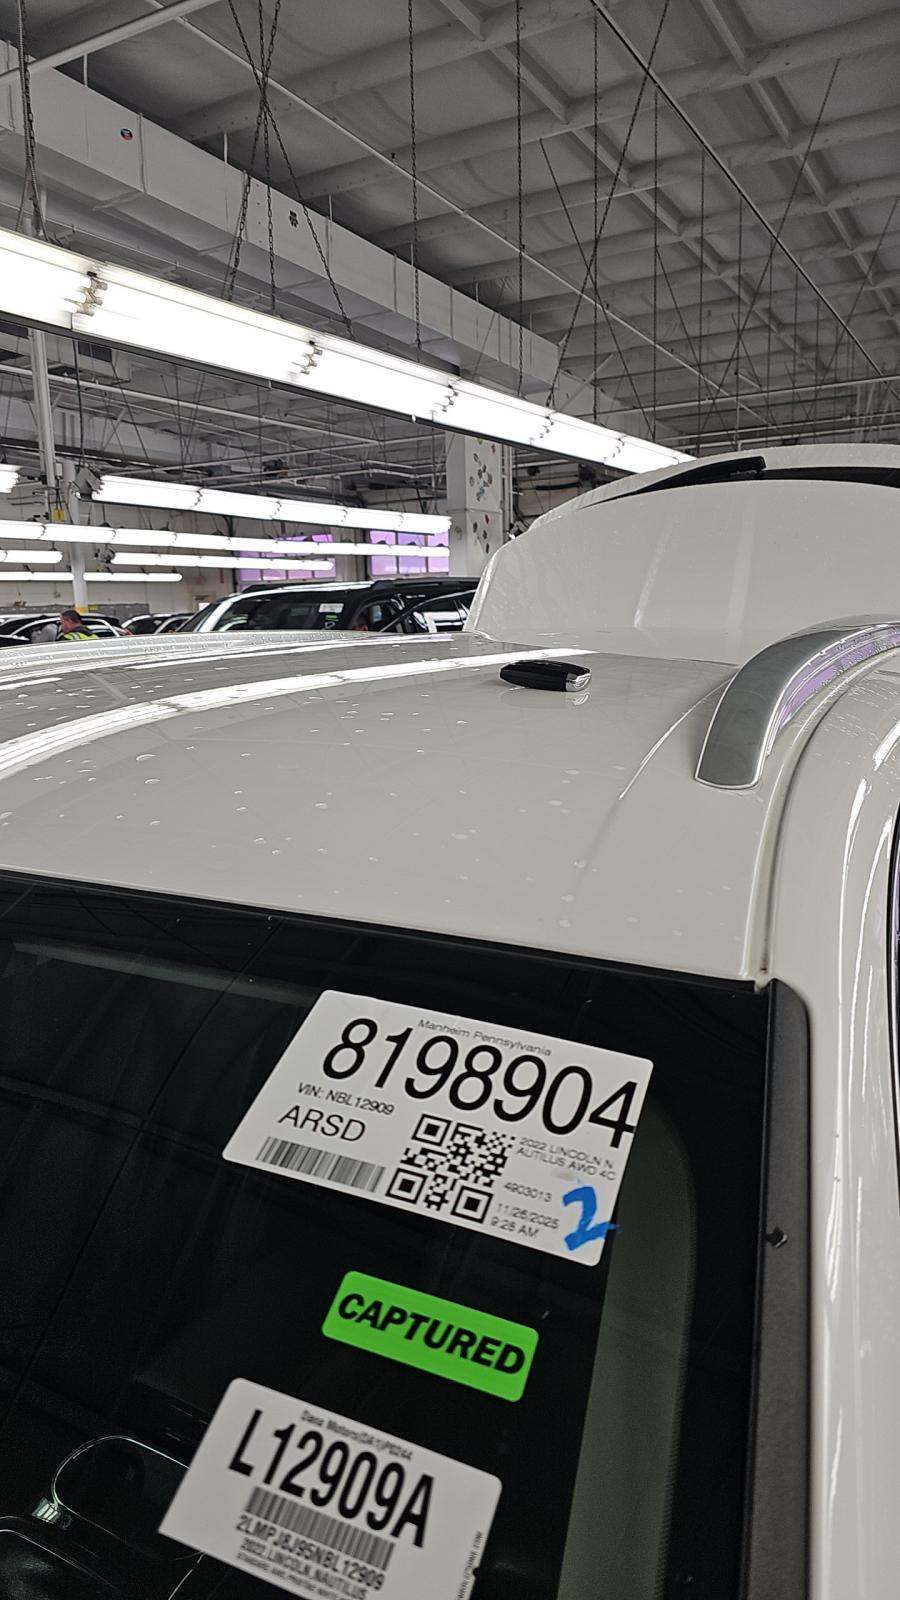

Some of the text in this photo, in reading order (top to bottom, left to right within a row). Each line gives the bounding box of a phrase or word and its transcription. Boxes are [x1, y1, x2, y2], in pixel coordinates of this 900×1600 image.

[418, 1019, 552, 1056] Manheim Pennsylvania
[298, 1082, 395, 1115] VIN: NBL12909
[322, 1018, 637, 1148] 8198904
[278, 1105, 366, 1142] ARSD
[517, 1147, 566, 1167] AUTILUS
[568, 1161, 598, 1176] AWD
[520, 1137, 547, 1152] 2022
[550, 1147, 601, 1166] LINCOLN
[518, 1225, 540, 1238] AM
[562, 1186, 618, 1251] 2
[337, 1293, 525, 1375] CAPTURED
[228, 1409, 435, 1548] L12909A
